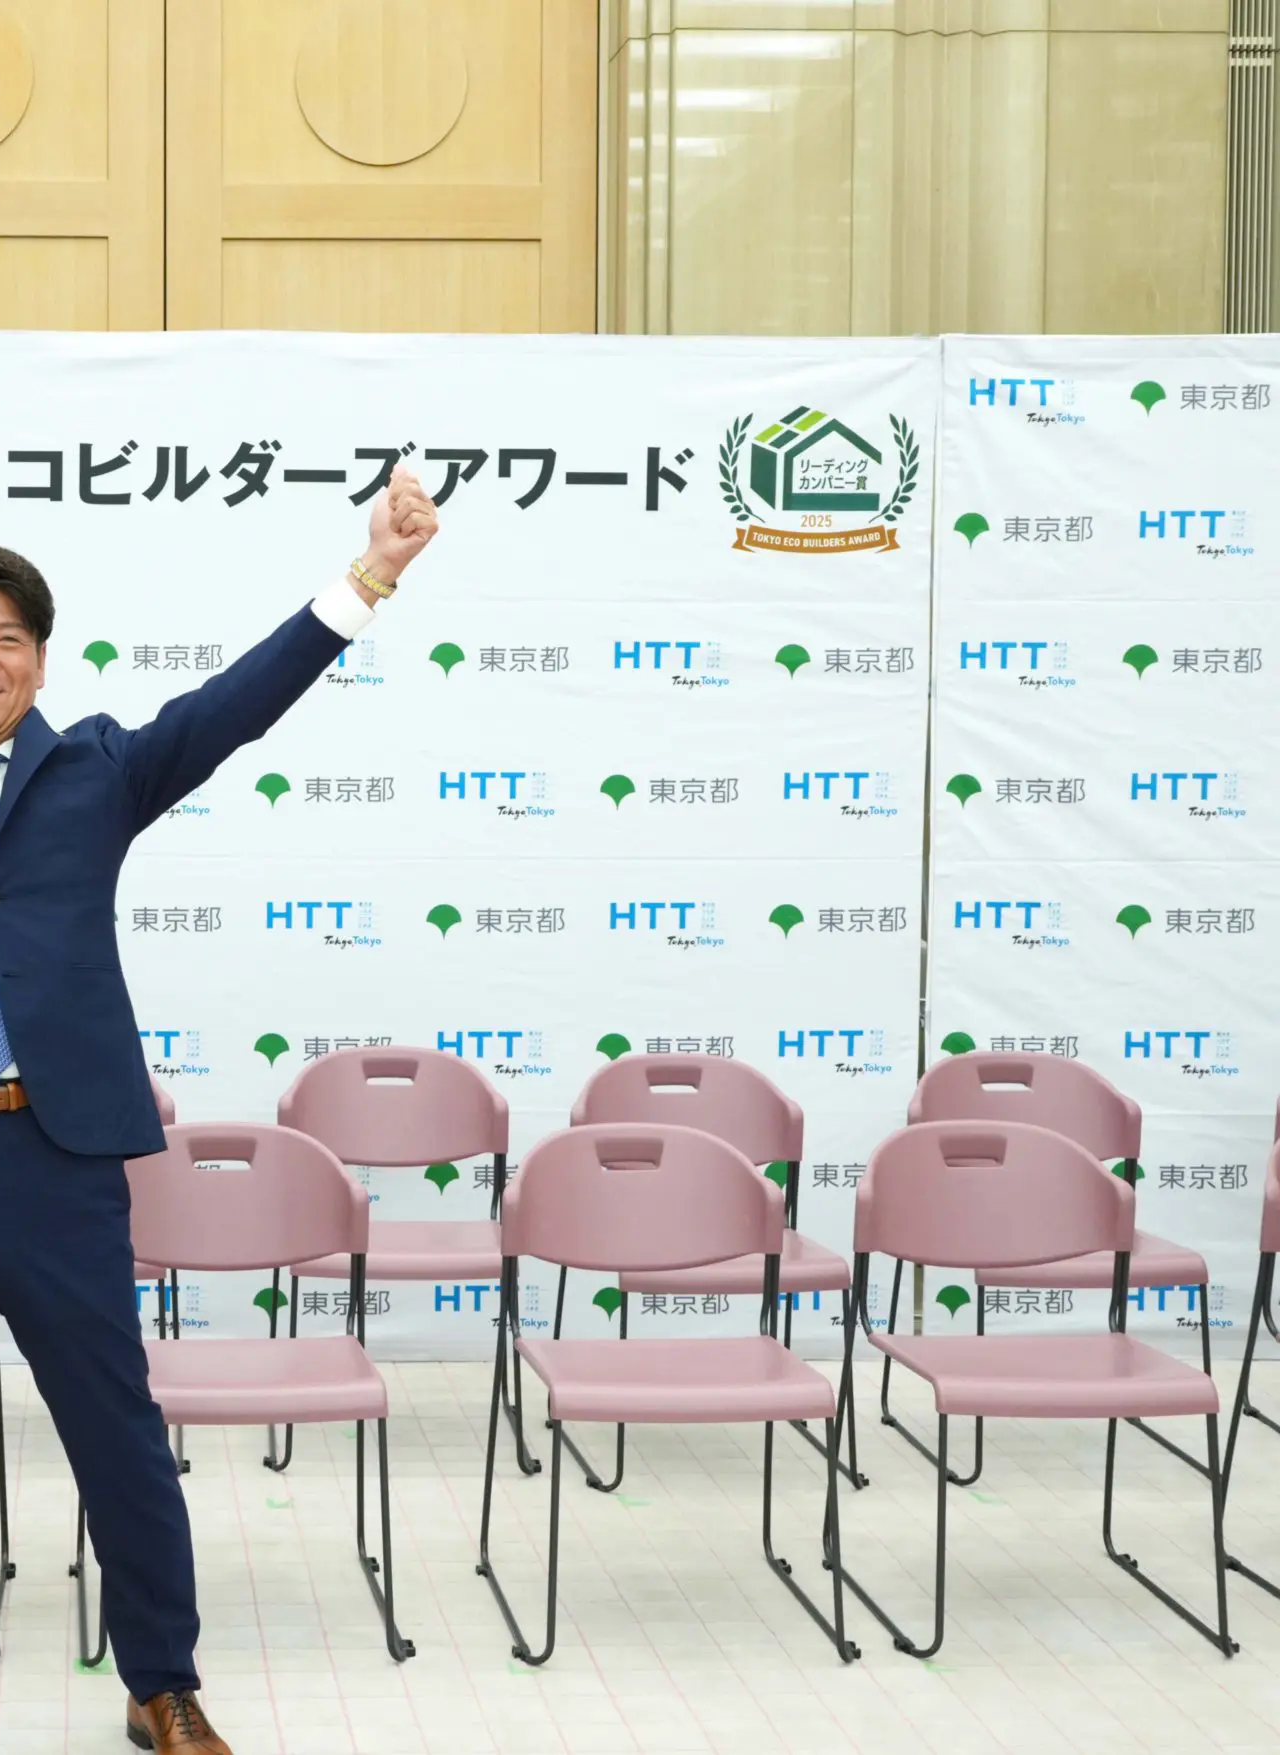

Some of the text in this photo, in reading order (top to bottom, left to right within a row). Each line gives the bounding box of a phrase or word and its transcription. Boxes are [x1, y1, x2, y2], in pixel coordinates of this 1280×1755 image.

[970, 379, 1054, 406] HTT
[1180, 384, 1271, 410] 東京都
[1026, 413, 1085, 428] Tokyo Tokyo
[799, 458, 870, 475] リーディング
[798, 475, 869, 491] カンパニー賞
[800, 514, 833, 528] 2025
[1003, 516, 1094, 542] 東京都
[1140, 511, 1225, 538] HTT
[752, 531, 881, 547] TOKYO ECO BUILDERS AWARD
[1196, 545, 1255, 560] Tokyo Tokyo
[132, 644, 223, 670] 東京都
[479, 646, 570, 673] 東京都
[615, 642, 700, 669] HTT
[824, 647, 915, 674] 東京都
[961, 642, 1047, 669] HTT
[1172, 648, 1263, 674] 東京都
[326, 674, 385, 689] Tokyo Tokyo
[672, 676, 731, 691] Tokyo Tokyo
[1018, 676, 1077, 691] Tokyo Tokyo
[305, 777, 395, 803] 東京都
[440, 772, 525, 799] HTT
[649, 778, 739, 804] 東京都
[784, 772, 869, 799] HTT
[996, 778, 1086, 804] 東京都
[1132, 773, 1217, 800] HTT
[181, 805, 210, 817] Tokyo
[497, 805, 556, 820] Tokyo Tokyo
[840, 805, 899, 820] Tokyo Tokyo
[1188, 807, 1247, 822] Tokyo Tokyo
[132, 907, 222, 933] 東京都
[267, 902, 352, 929] HTT
[476, 908, 566, 934] 東京都
[611, 903, 695, 929] HTT
[818, 907, 907, 933] 東京都
[955, 902, 1041, 929] HTT
[1165, 908, 1255, 935] 東京都
[324, 935, 383, 950] Tokyo Tokyo
[667, 936, 726, 951] Tokyo Tokyo
[1012, 935, 1071, 950] Tokyo Tokyo
[437, 1031, 523, 1058] HTT
[778, 1030, 864, 1057] HTT
[1124, 1032, 1210, 1058] HTT
[152, 1064, 211, 1079] Tokyo Tokyo
[494, 1064, 553, 1079] Tokyo Tokyo
[835, 1063, 894, 1078] Tokyo Tokyo
[1181, 1065, 1240, 1080] Tokyo Tokyo
[1159, 1164, 1248, 1190] 東京都
[982, 1288, 1074, 1314] 東京都
[181, 1318, 210, 1330] Tokyo
[520, 1318, 549, 1330] Tokyo
